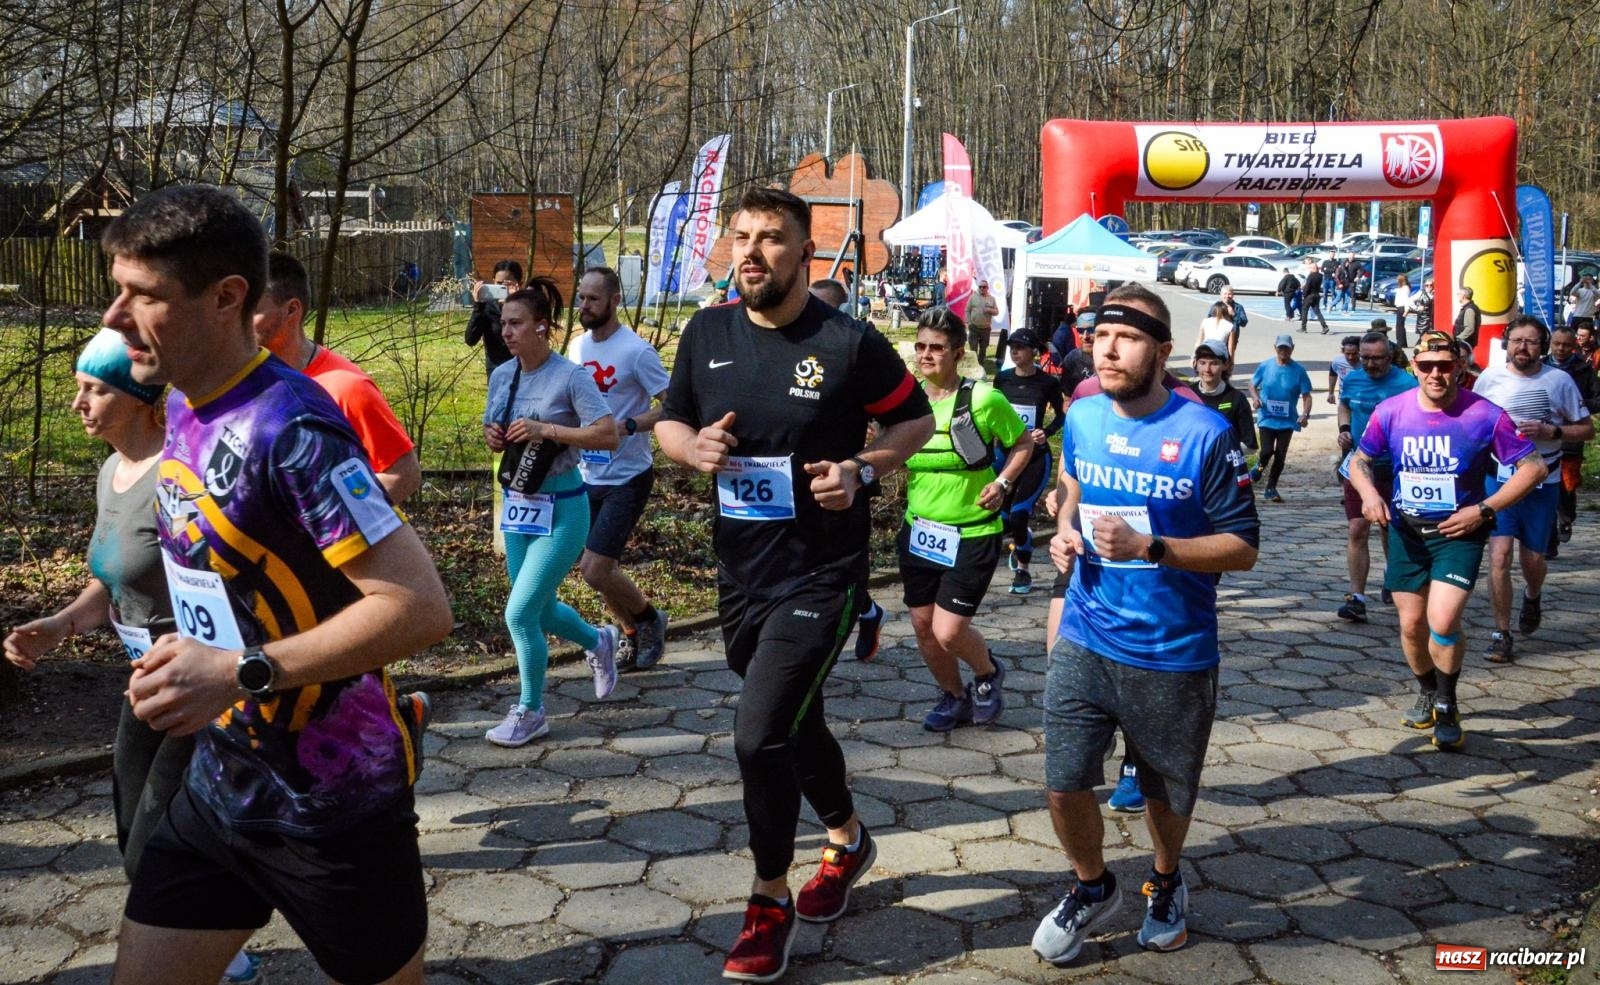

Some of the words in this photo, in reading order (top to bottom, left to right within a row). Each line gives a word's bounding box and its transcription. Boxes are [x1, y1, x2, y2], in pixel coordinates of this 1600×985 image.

[1264, 132, 1317, 144] BIEG
[1223, 152, 1363, 169] TWARDZIELA
[1235, 173, 1348, 191] RACIBÓRZ
[692, 150, 721, 260] RACIBÓRZ
[789, 387, 820, 400] POLSKA
[1402, 435, 1451, 467] RUN
[730, 478, 773, 502] 126
[1411, 486, 1442, 501] 091
[508, 505, 542, 523] 077
[918, 531, 947, 552] 034
